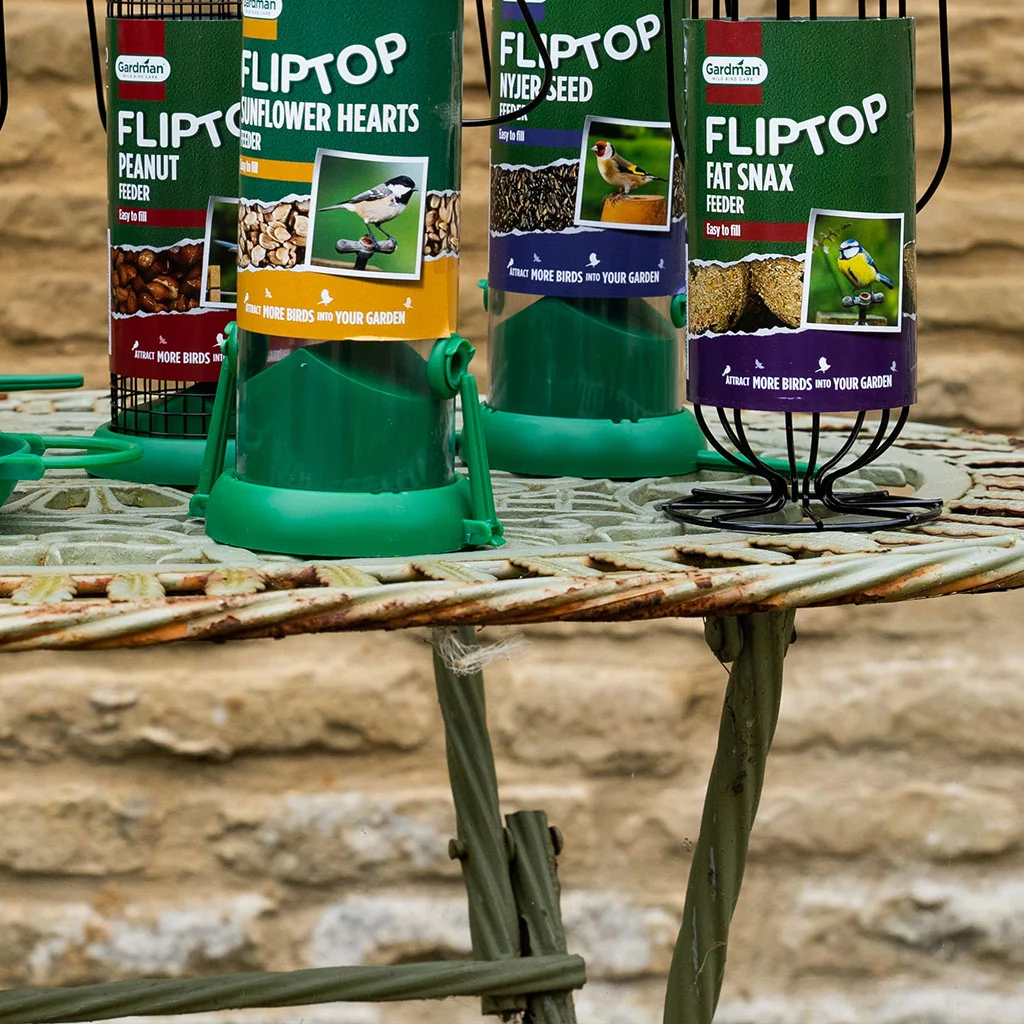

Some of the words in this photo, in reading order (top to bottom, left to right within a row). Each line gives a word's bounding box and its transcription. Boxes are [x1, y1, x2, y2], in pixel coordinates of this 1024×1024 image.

[500, 13, 662, 70] FLIPTOP
[118, 61, 164, 74] Gardman
[241, 32, 407, 95] FLIPTOP
[706, 63, 760, 76] Gardman
[500, 72, 541, 100] NYJER
[546, 76, 593, 102] SEED
[241, 95, 331, 132] SUNFLOWER
[337, 103, 419, 133] HEARTS
[118, 102, 240, 148] FLIPT
[705, 93, 887, 156] FLIPTOP
[498, 128, 510, 142] Easy
[509, 130, 516, 141] to
[516, 130, 525, 141] fill
[118, 152, 179, 181] PEANUT
[706, 162, 733, 190] FAT
[737, 163, 794, 192] SNAX
[118, 183, 150, 202] FEEDER
[706, 195, 745, 214] FEEDER
[118, 209, 132, 223] Easy
[131, 210, 138, 221] to
[138, 211, 147, 223] fill
[706, 223, 720, 238] Easy
[721, 225, 730, 236] to
[731, 224, 741, 237] fill
[509, 266, 529, 278] ATTRACT
[531, 269, 554, 282] MORE
[556, 270, 583, 283] BIRDS
[585, 273, 601, 282] INTO
[602, 271, 627, 284] YOUR
[628, 270, 660, 283] GARDEN
[263, 305, 285, 320] MORE
[286, 307, 314, 323] BIRDS
[317, 311, 333, 321] INTO
[335, 310, 363, 325] YOUR
[366, 310, 405, 325] GARDEN
[134, 350, 154, 360] ATTRACT
[157, 350, 181, 363] MORE
[183, 351, 210, 364] BIRDS
[213, 353, 225, 362] INT
[726, 374, 750, 386] ATTRACT
[753, 376, 779, 390] MORE
[782, 376, 812, 391] BIRDS
[815, 379, 831, 388] INTO
[833, 376, 858, 390] YOUR
[860, 374, 892, 389] GARDEN
